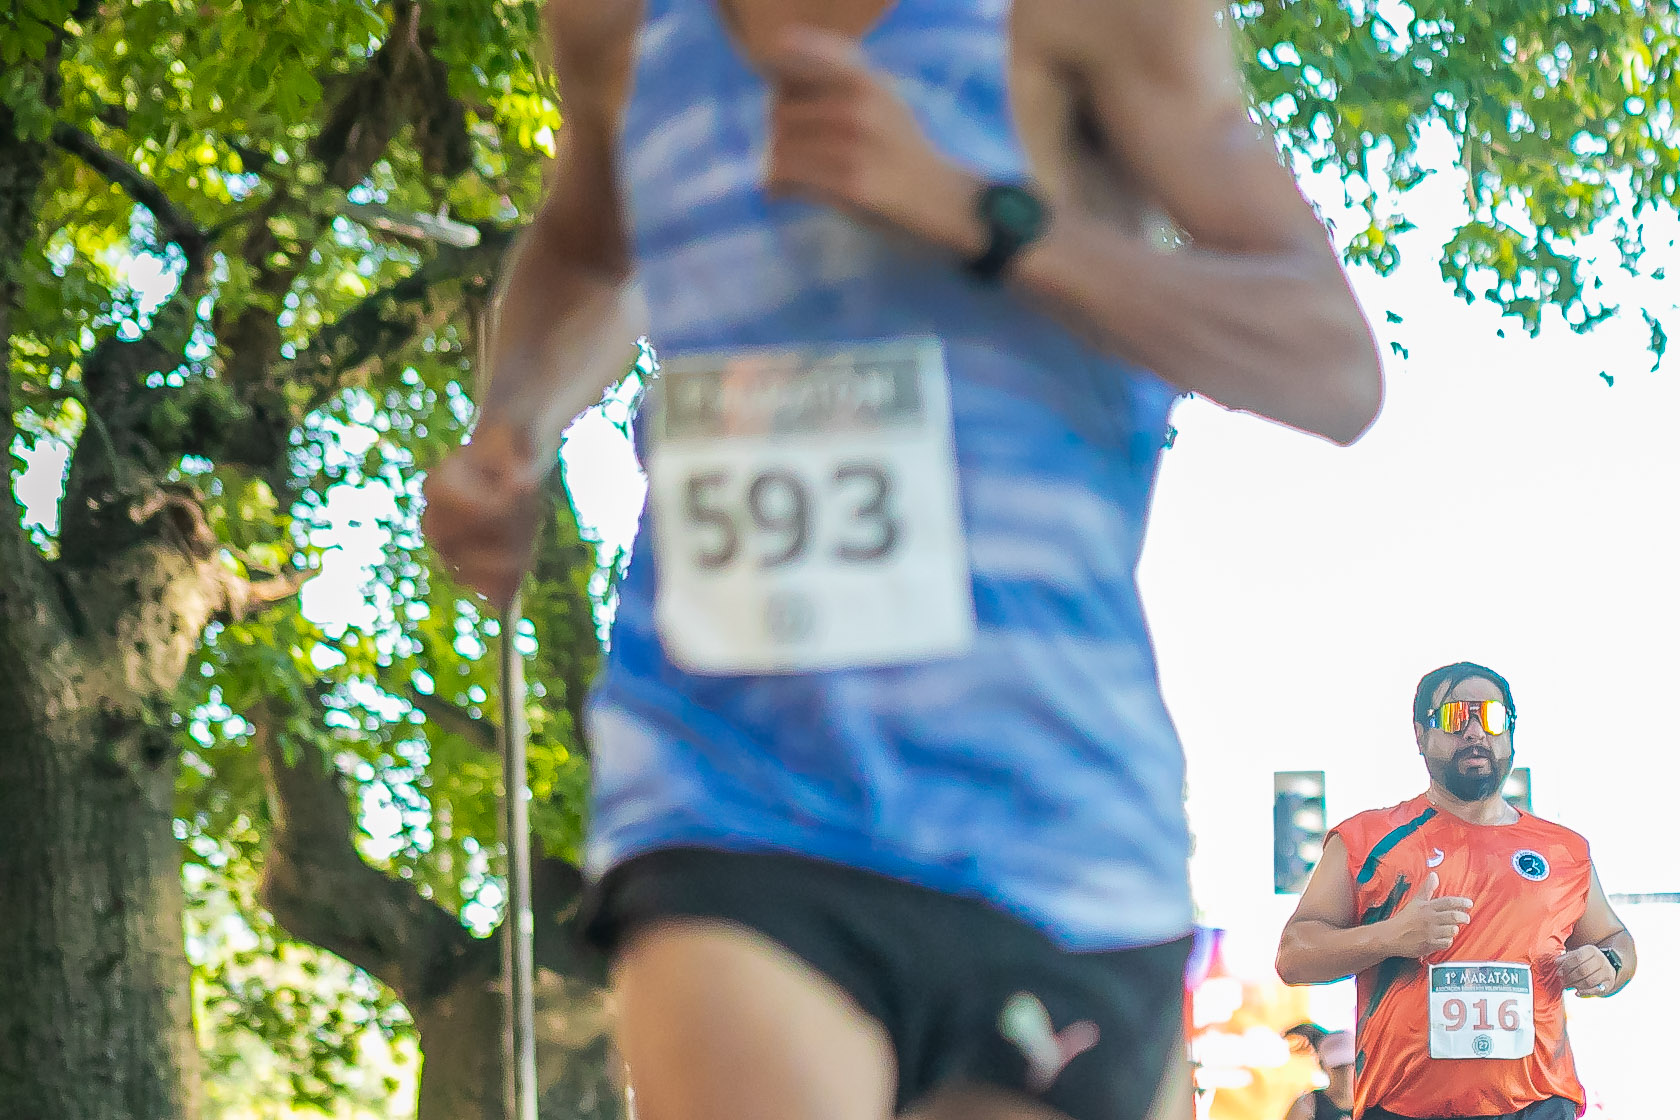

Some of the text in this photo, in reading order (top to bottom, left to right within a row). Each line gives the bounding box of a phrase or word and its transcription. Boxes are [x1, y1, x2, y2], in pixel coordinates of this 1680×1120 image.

[681, 459, 904, 570] 593
[1460, 969, 1519, 984] MARATÓN
[1442, 998, 1520, 1031] 916
